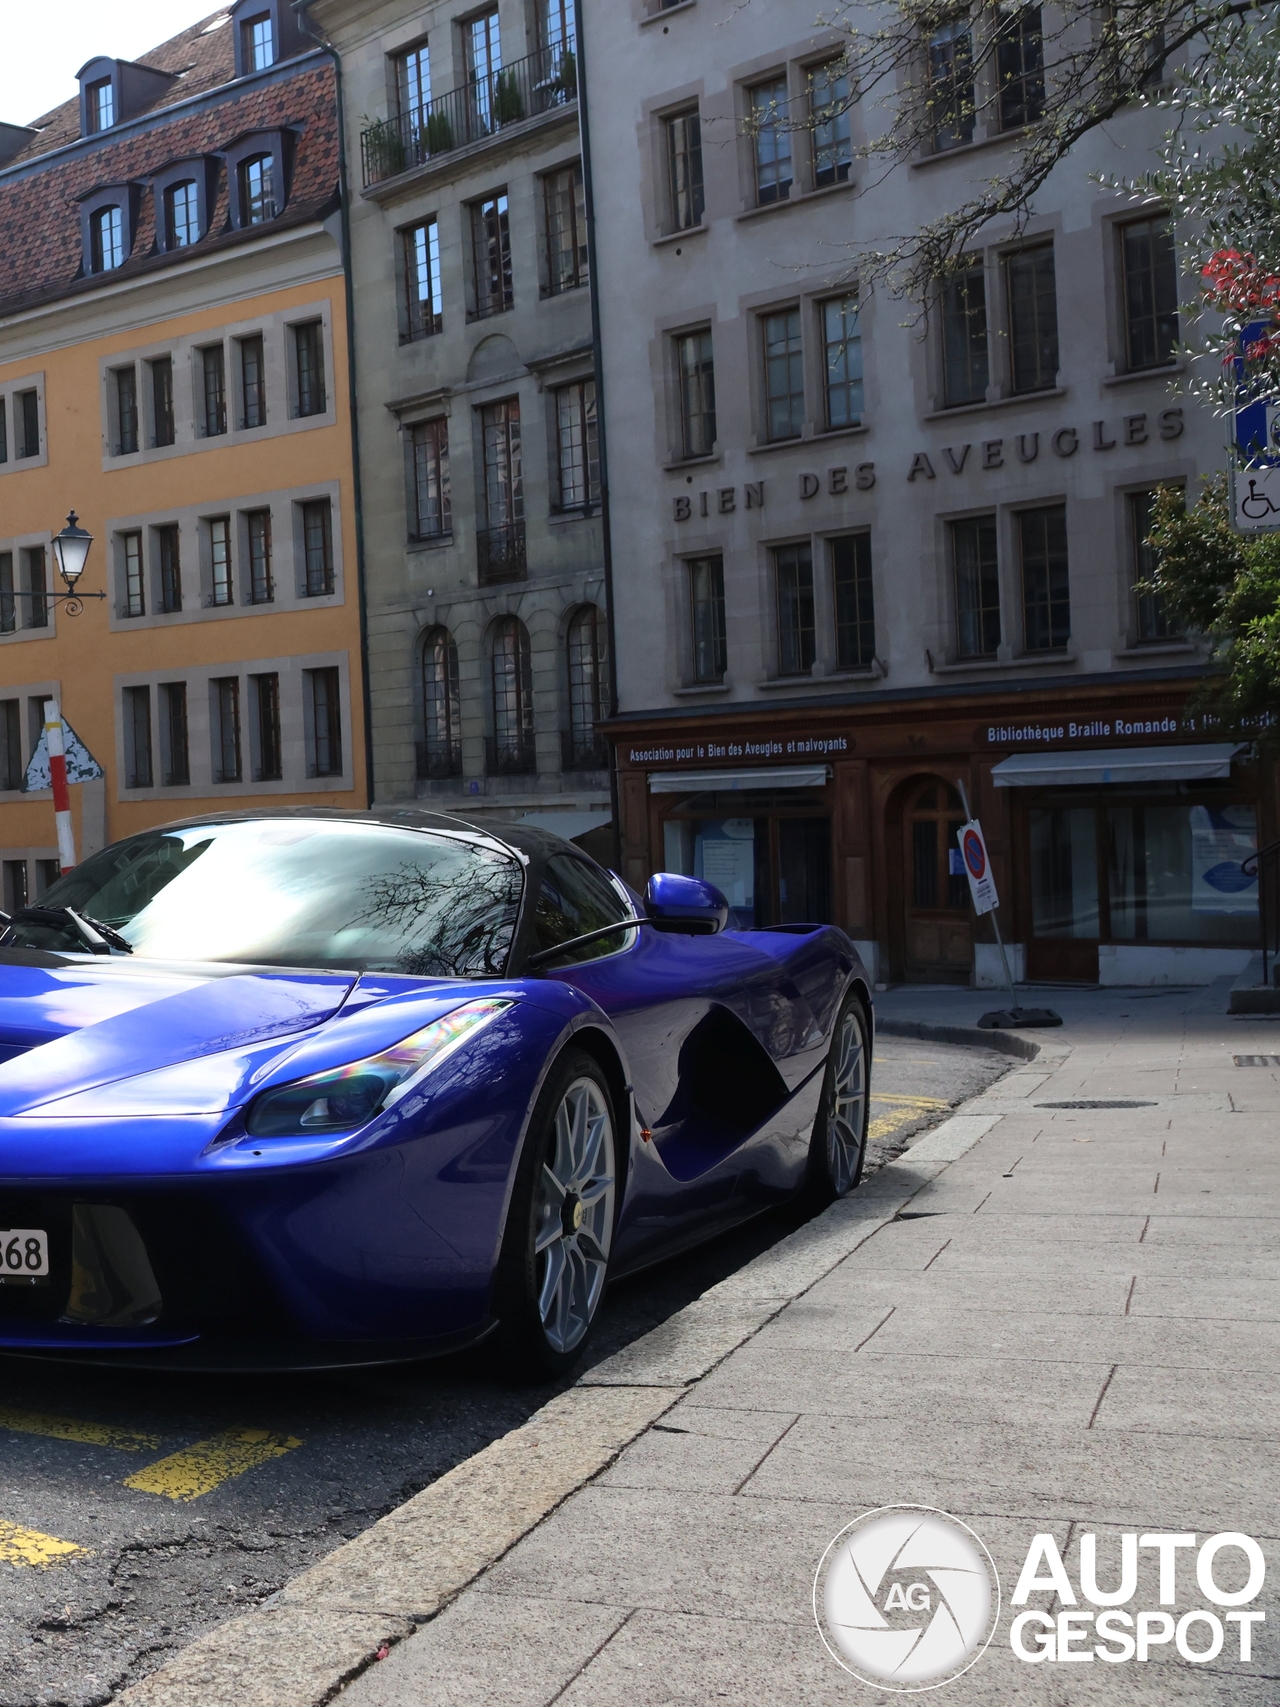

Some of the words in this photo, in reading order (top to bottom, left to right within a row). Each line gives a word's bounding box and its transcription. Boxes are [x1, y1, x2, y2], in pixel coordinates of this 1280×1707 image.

[672, 481, 764, 522] BIEN
[800, 462, 875, 499] DES
[907, 407, 1184, 481] AVEUGLES
[988, 724, 1064, 742] Bibliothèque
[1069, 721, 1110, 738] Braille
[1116, 717, 1177, 735] Romande
[630, 749, 674, 762] Association
[677, 748, 694, 761] pour
[697, 745, 705, 758] le
[708, 743, 726, 757] Bien
[728, 742, 742, 756] des
[745, 741, 783, 757] Aveugles
[787, 739, 796, 753] et
[797, 737, 848, 754] malvoyants
